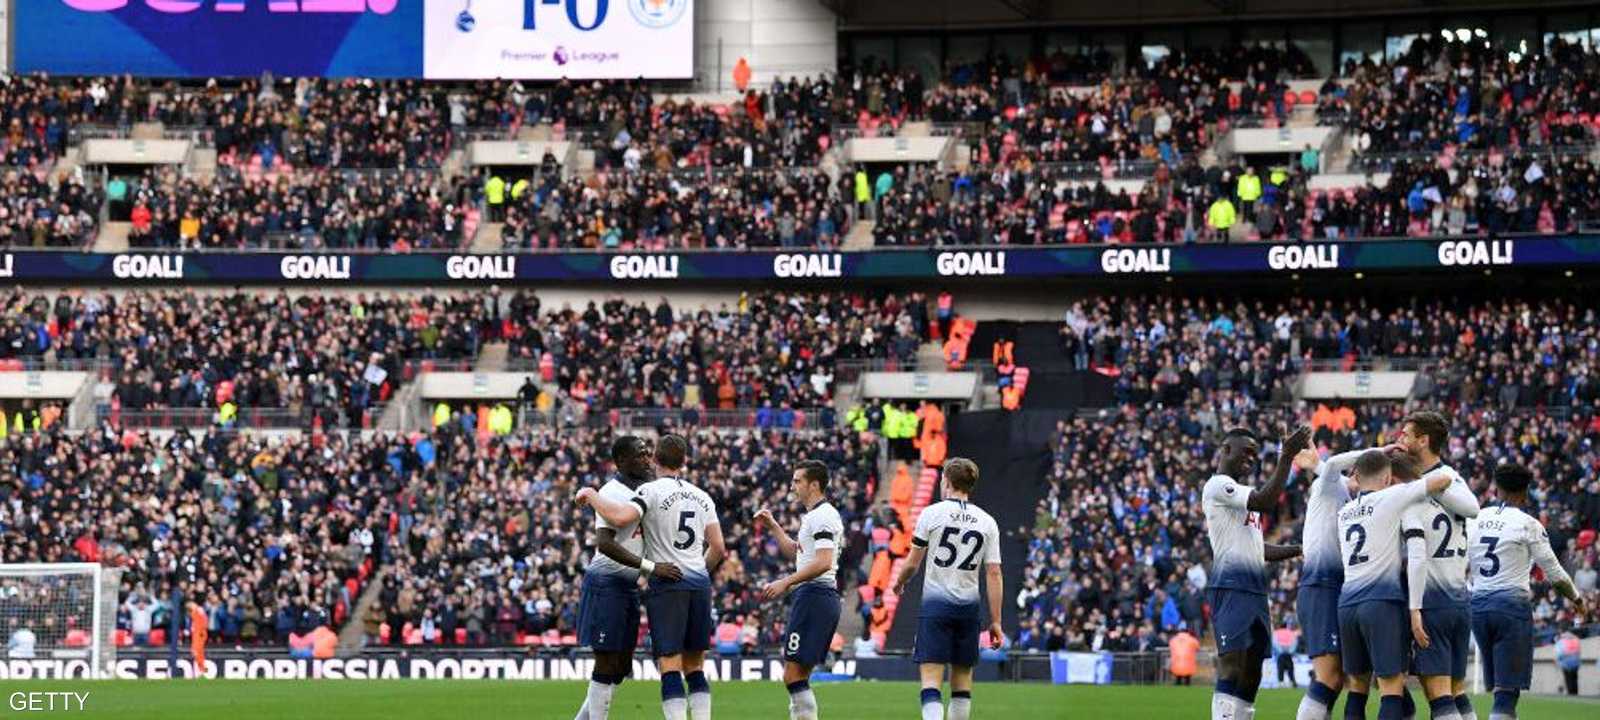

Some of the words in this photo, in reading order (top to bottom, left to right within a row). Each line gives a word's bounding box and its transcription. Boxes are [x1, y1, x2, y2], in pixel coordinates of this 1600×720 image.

[501, 49, 546, 60] Premier
[573, 49, 619, 62] League
[774, 253, 842, 278] GOAL!
[937, 251, 1005, 276] GOAL!
[1101, 248, 1171, 273] GOAL!
[1268, 244, 1339, 270] GOAL!
[1438, 240, 1513, 266] GOAL!
[112, 254, 184, 278] GOAL!
[281, 255, 351, 279] GOAL!
[446, 255, 516, 279] GOAL!
[610, 254, 679, 279] GOAL!
[673, 510, 696, 551] 5
[933, 526, 984, 571] 52
[1345, 523, 1369, 567] 2
[1479, 536, 1500, 578] 3
[788, 632, 801, 651] 8
